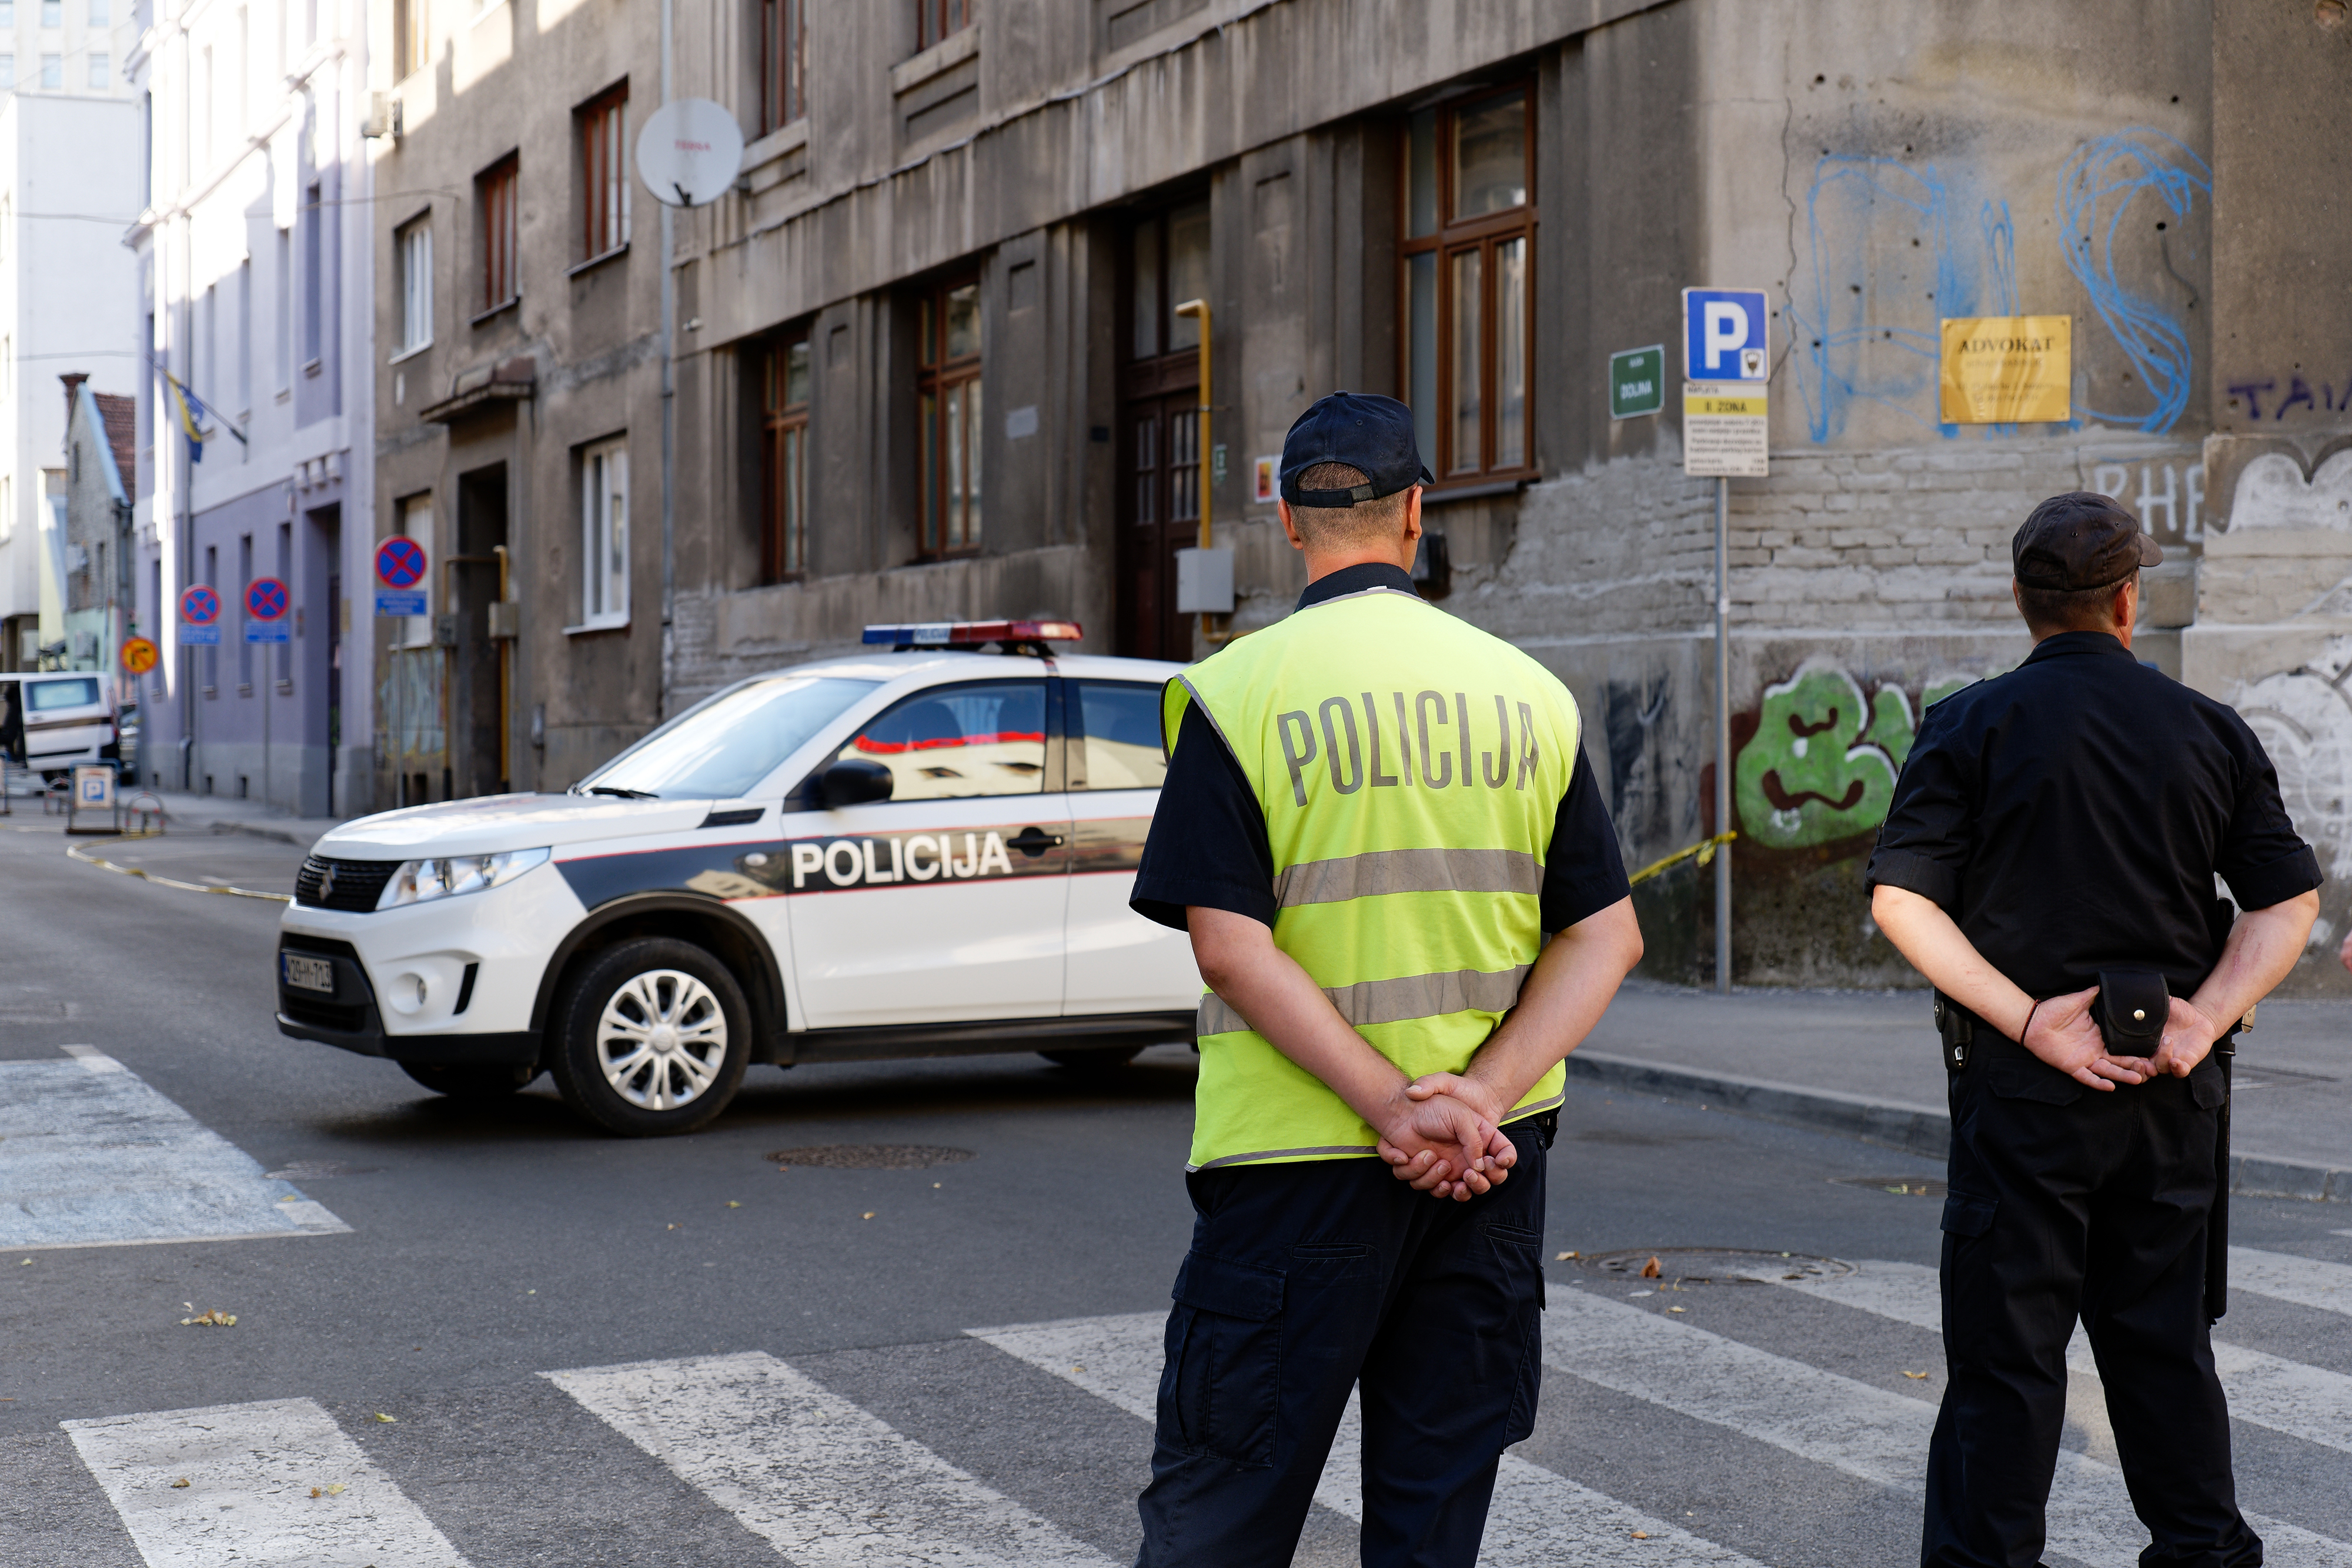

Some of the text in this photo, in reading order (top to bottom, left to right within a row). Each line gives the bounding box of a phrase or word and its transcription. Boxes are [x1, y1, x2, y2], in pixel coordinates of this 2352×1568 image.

[1705, 302, 1749, 369] P
[1959, 336, 2054, 354] ADVOKAT
[1717, 400, 1748, 412] ZONA
[1277, 690, 1539, 807] POLICIJA
[791, 831, 1013, 888] POLICIJA
